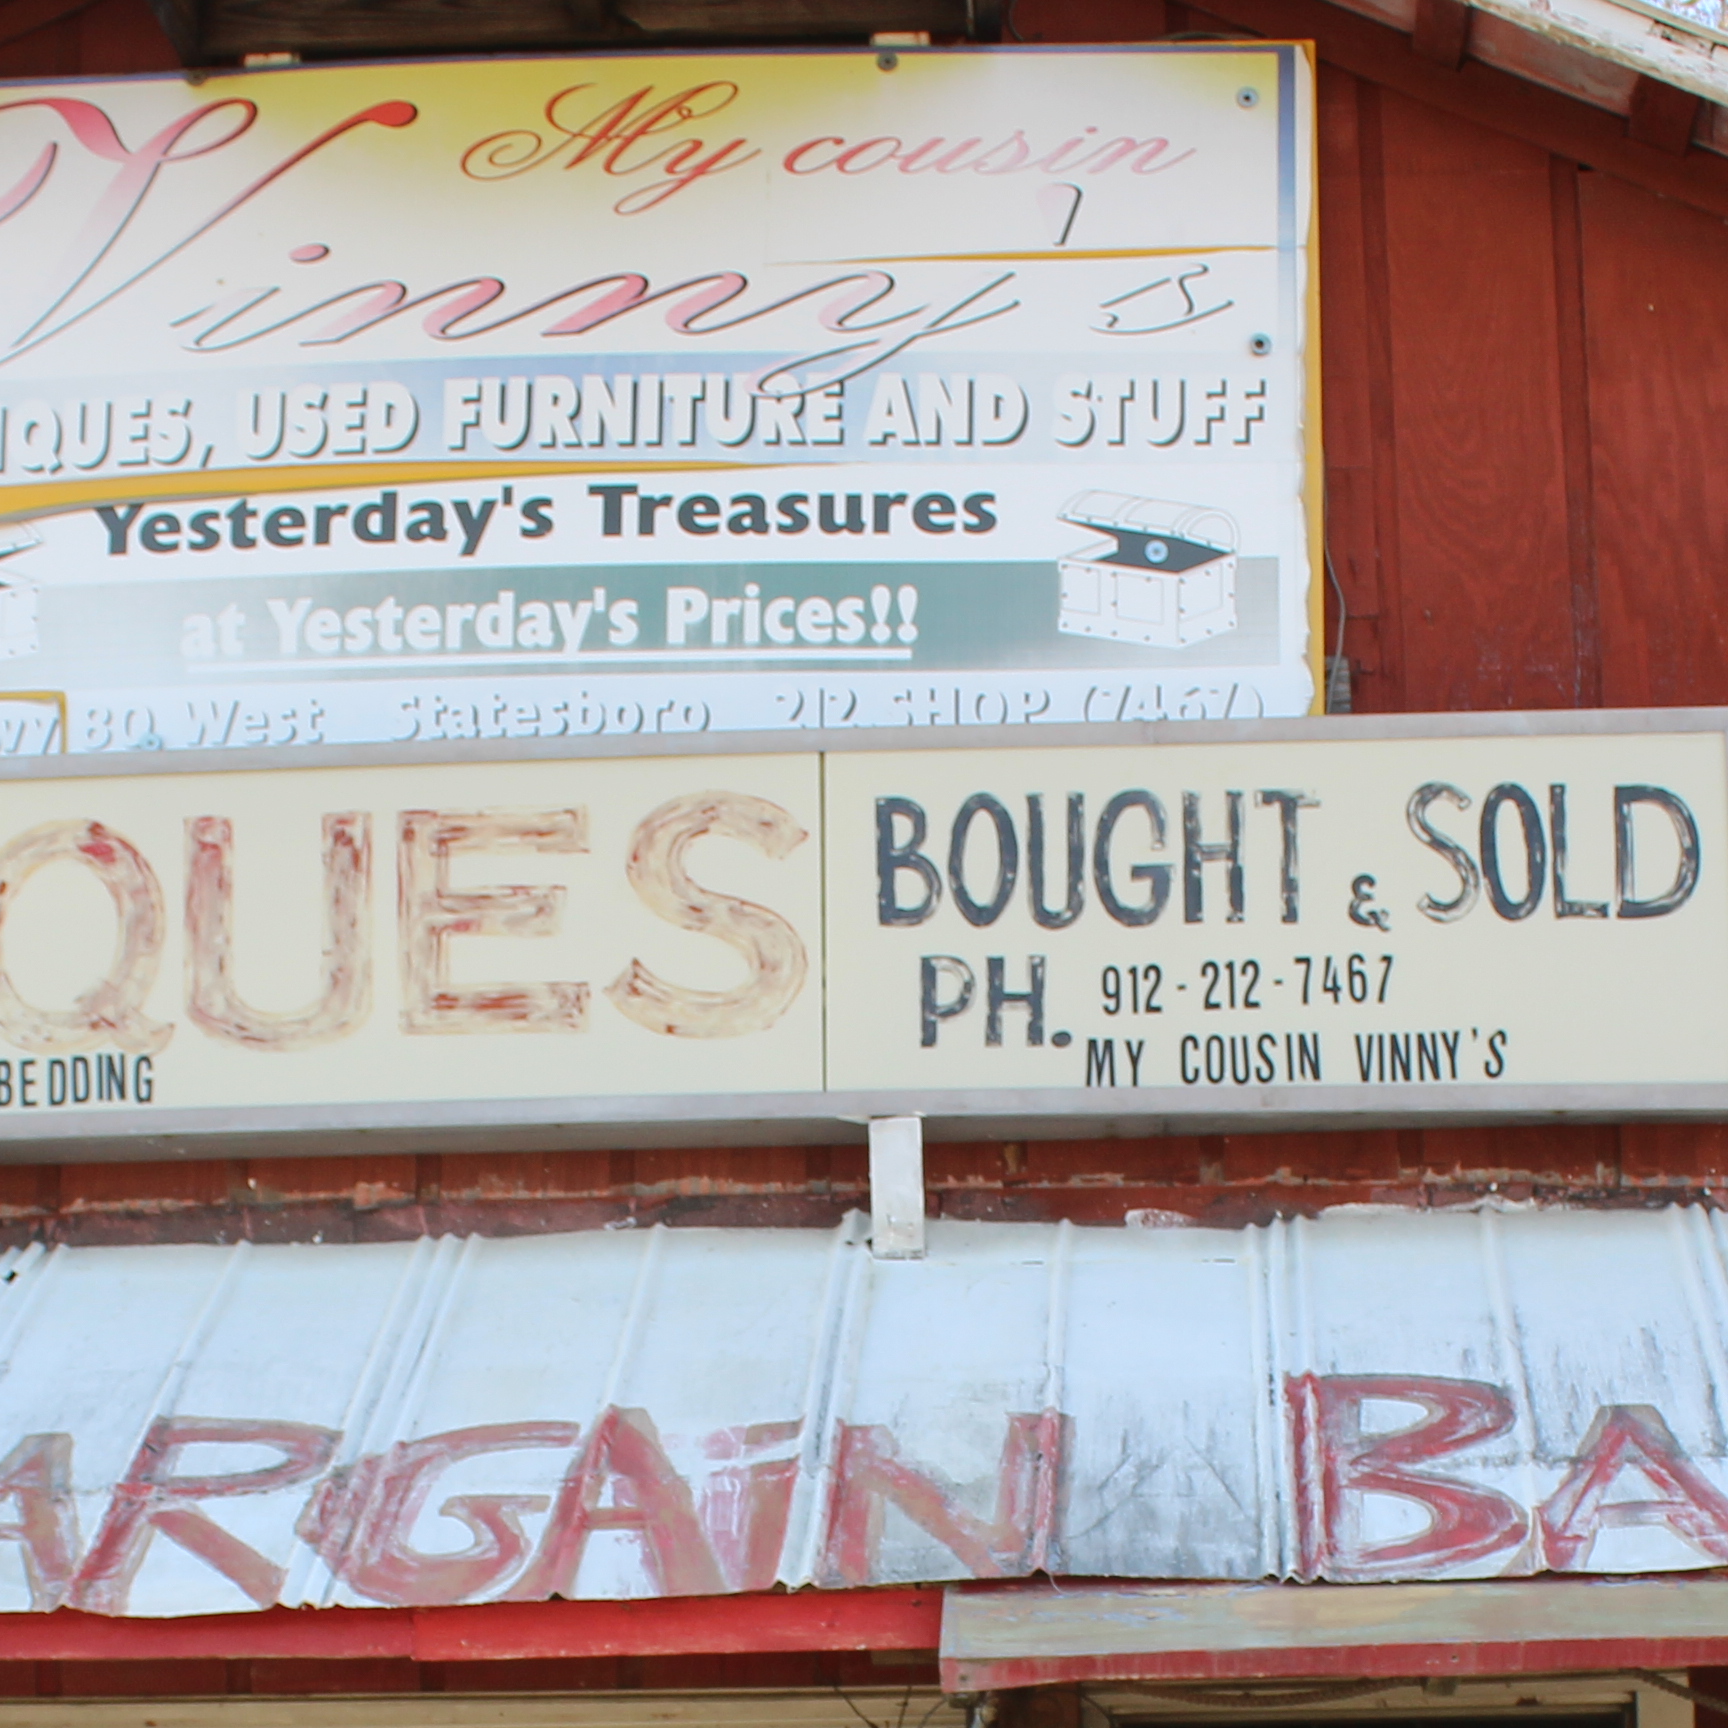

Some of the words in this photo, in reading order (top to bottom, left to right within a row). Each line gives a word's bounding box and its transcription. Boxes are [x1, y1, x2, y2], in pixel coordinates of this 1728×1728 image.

[459, 80, 762, 216] My
[782, 120, 1198, 177] cousin
[236, 383, 420, 462] USED
[442, 375, 846, 454] FURNITURE
[866, 373, 1029, 448] AND
[1052, 372, 1268, 449] STUFF
[92, 486, 556, 560] Yesterday's
[587, 484, 1000, 540] Treasures
[182, 602, 246, 657] at
[269, 592, 642, 658] Yesterday's
[665, 585, 921, 650] Prices!!
[82, 703, 158, 751] 80
[184, 698, 326, 746] West
[390, 692, 712, 743] Statesboro
[890, 683, 1052, 726] SHOP
[872, 787, 1321, 931] BOUGHT
[1346, 872, 1392, 932] &
[1406, 781, 1702, 924] SOLD
[918, 953, 1074, 1050] PH.
[1084, 1036, 1146, 1088] MY
[1180, 1032, 1323, 1086] COUSIN
[1355, 1028, 1509, 1084] VINNY'S
